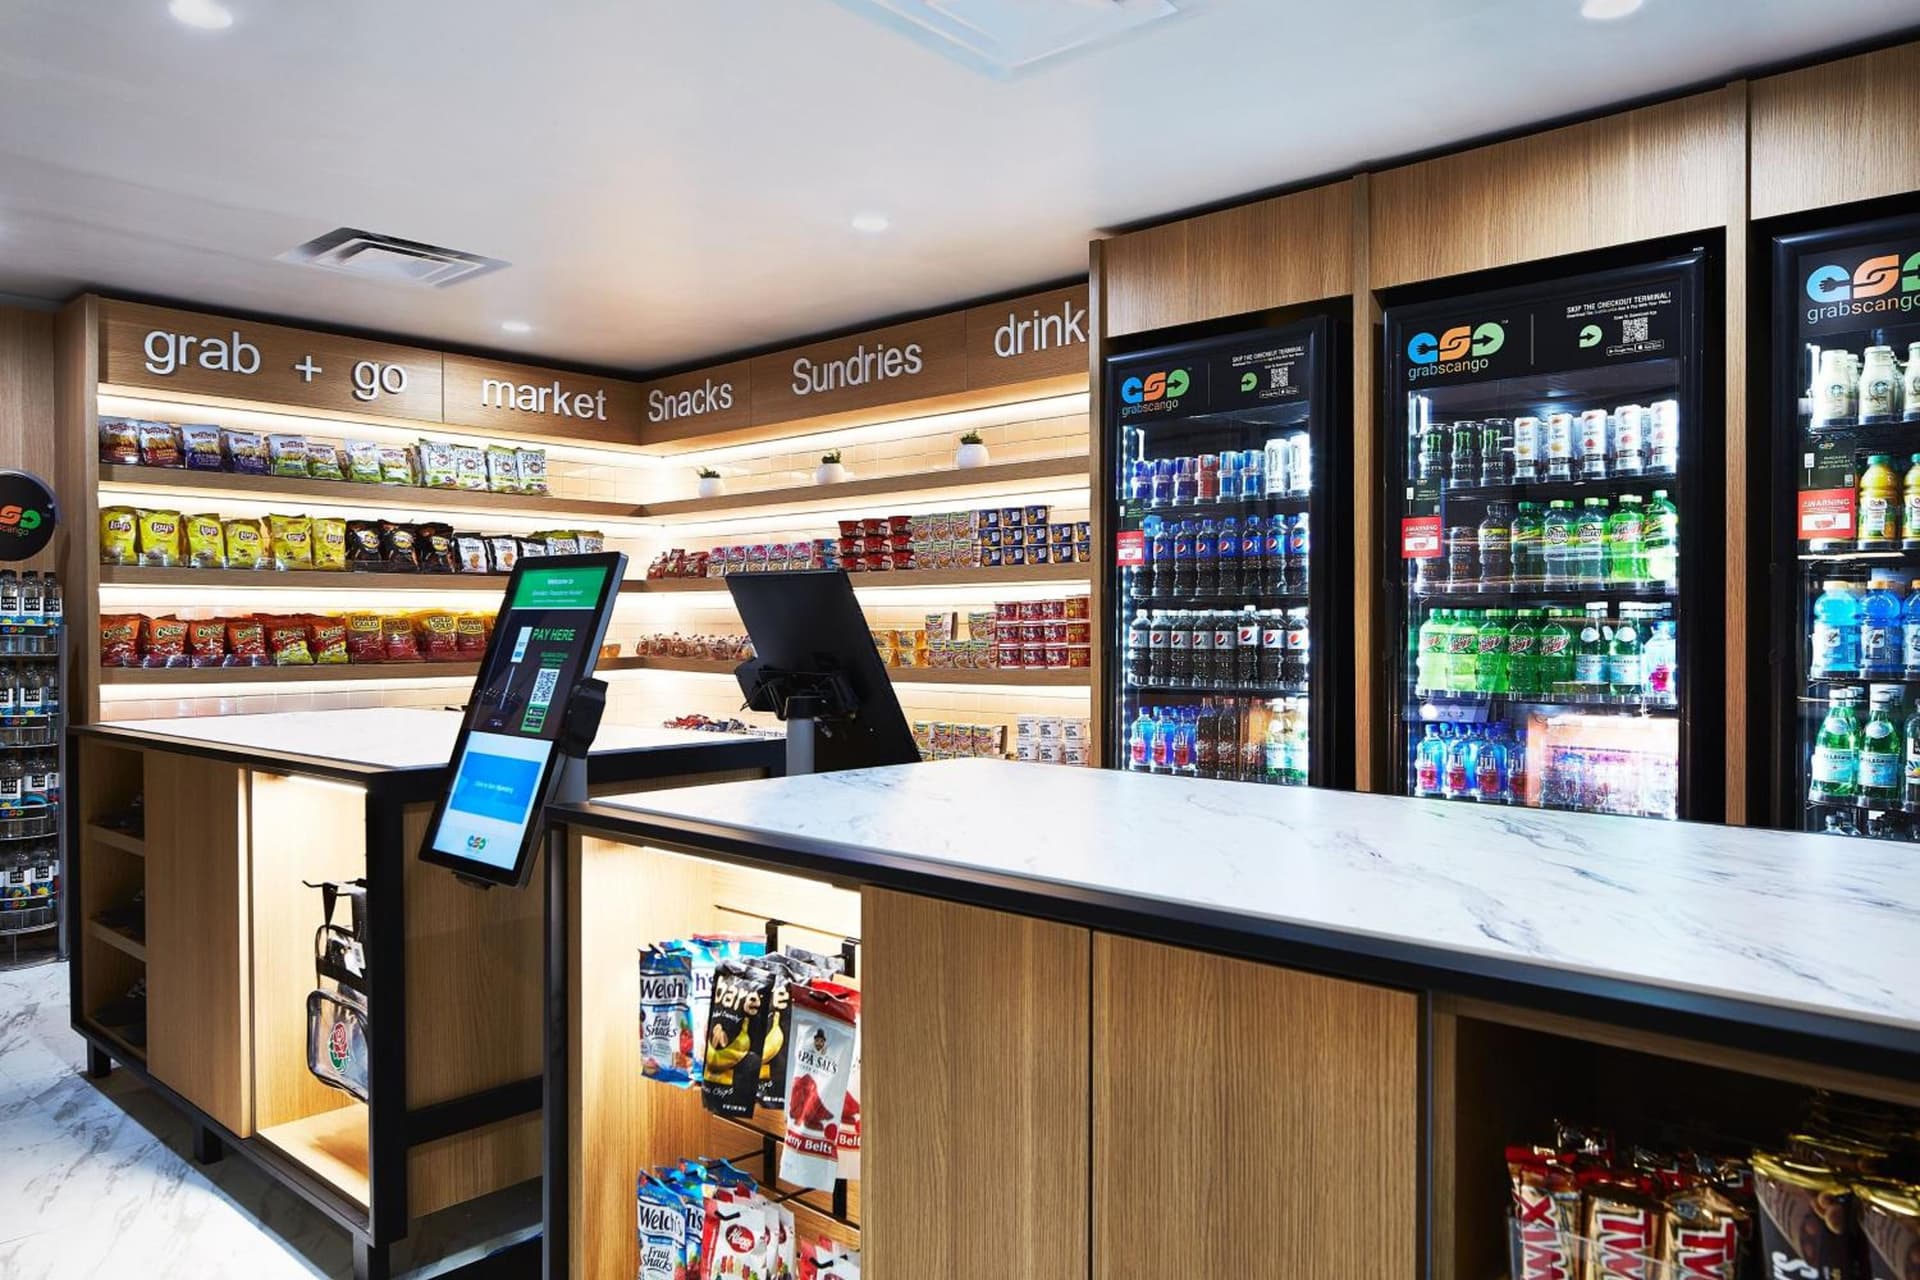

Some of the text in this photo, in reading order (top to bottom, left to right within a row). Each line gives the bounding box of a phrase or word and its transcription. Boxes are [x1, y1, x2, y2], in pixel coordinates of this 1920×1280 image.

[994, 301, 1090, 358] drink
[143, 330, 607, 420] grab + go market
[792, 342, 923, 395] Sundries
[1408, 358, 1489, 381] grabscango
[648, 379, 733, 422] Snacks
[1122, 399, 1179, 418] grabscango
[532, 629, 576, 641] PAY HERE
[714, 975, 761, 1016] bare
[645, 1025, 677, 1038] Snacks
[804, 1139, 832, 1154] Belts
[840, 1134, 861, 1146] Belt
[649, 1246, 671, 1258] Fruit
[642, 1254, 673, 1271] Snacks
